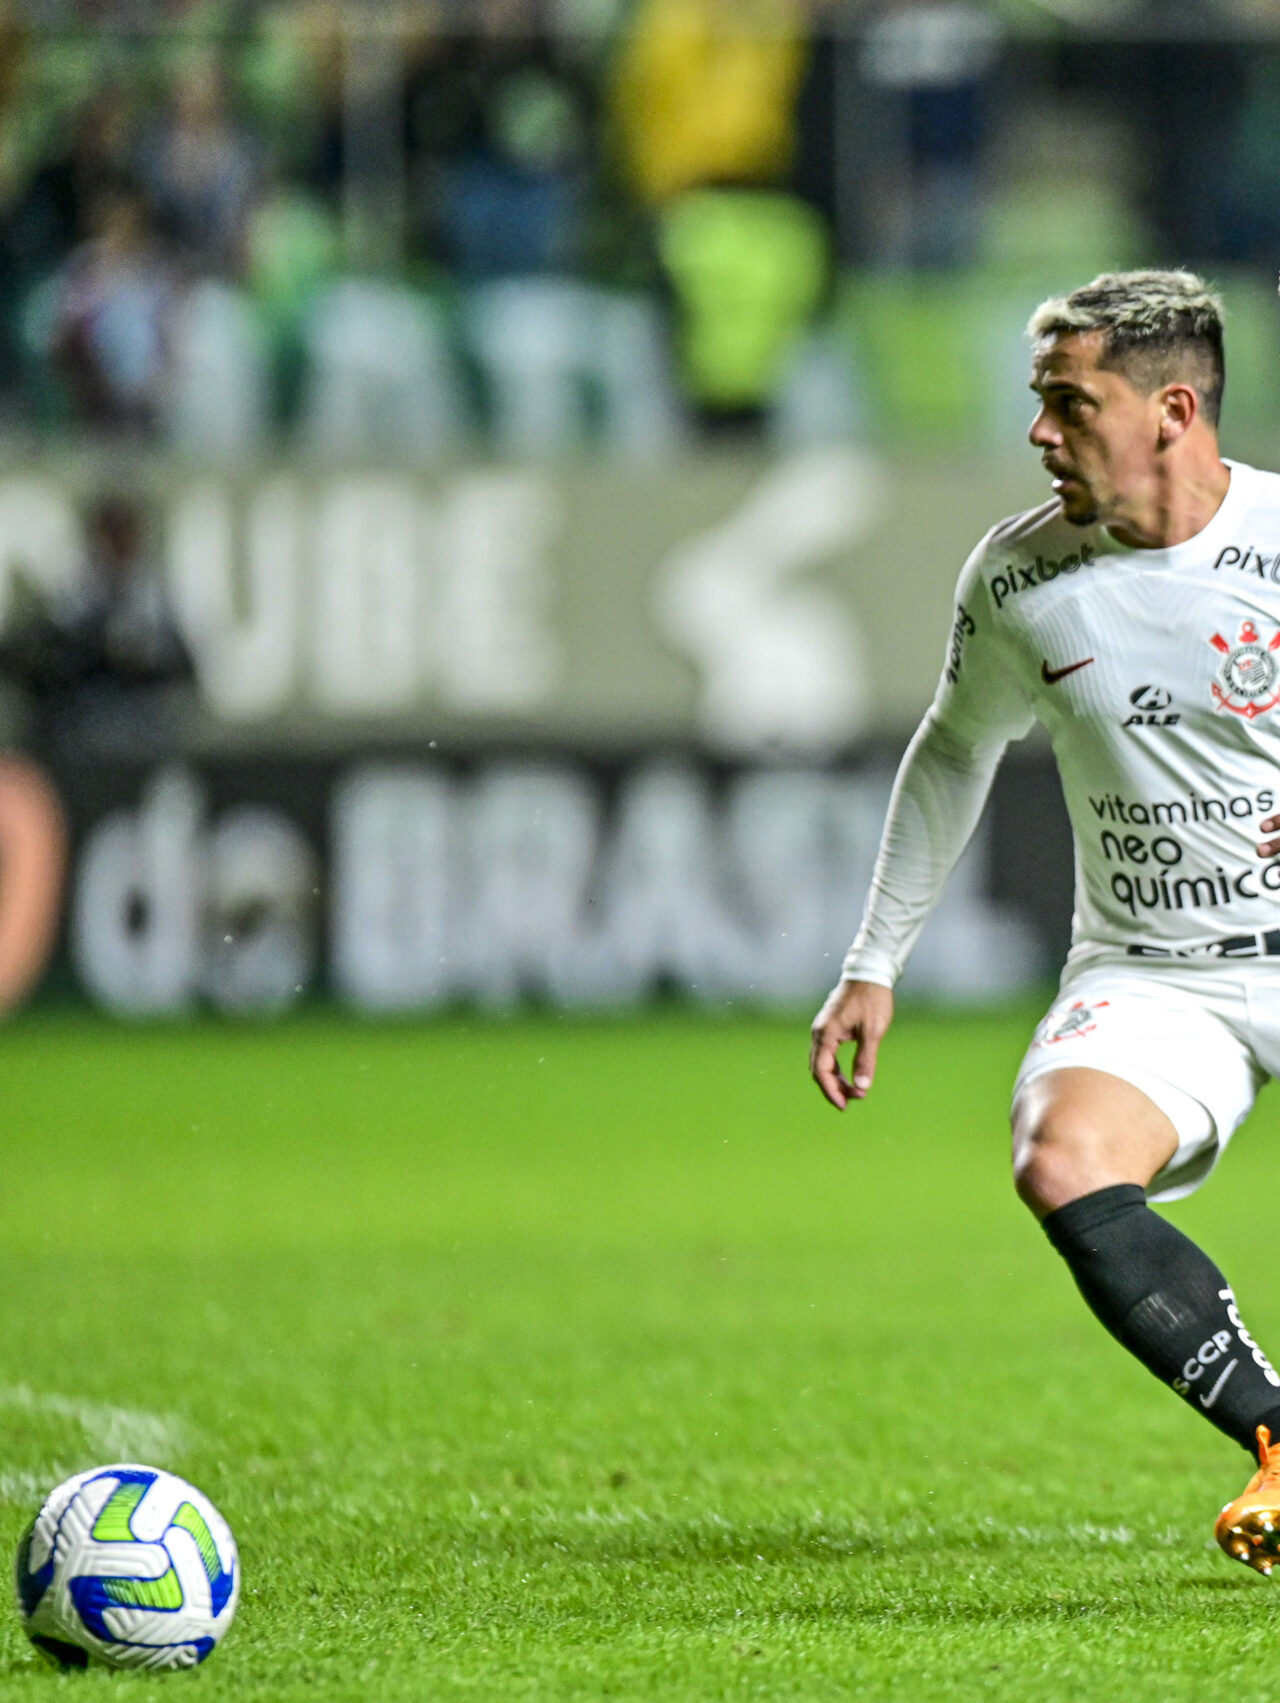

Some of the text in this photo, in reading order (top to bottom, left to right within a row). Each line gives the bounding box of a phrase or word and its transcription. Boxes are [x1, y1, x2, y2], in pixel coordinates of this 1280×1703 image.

[990, 543, 1095, 609] pixbet
[1121, 713, 1181, 728] ALE
[1088, 789, 1274, 825] vitaminas
[1100, 829, 1183, 866] neo
[1171, 1329, 1233, 1395] SCCP
